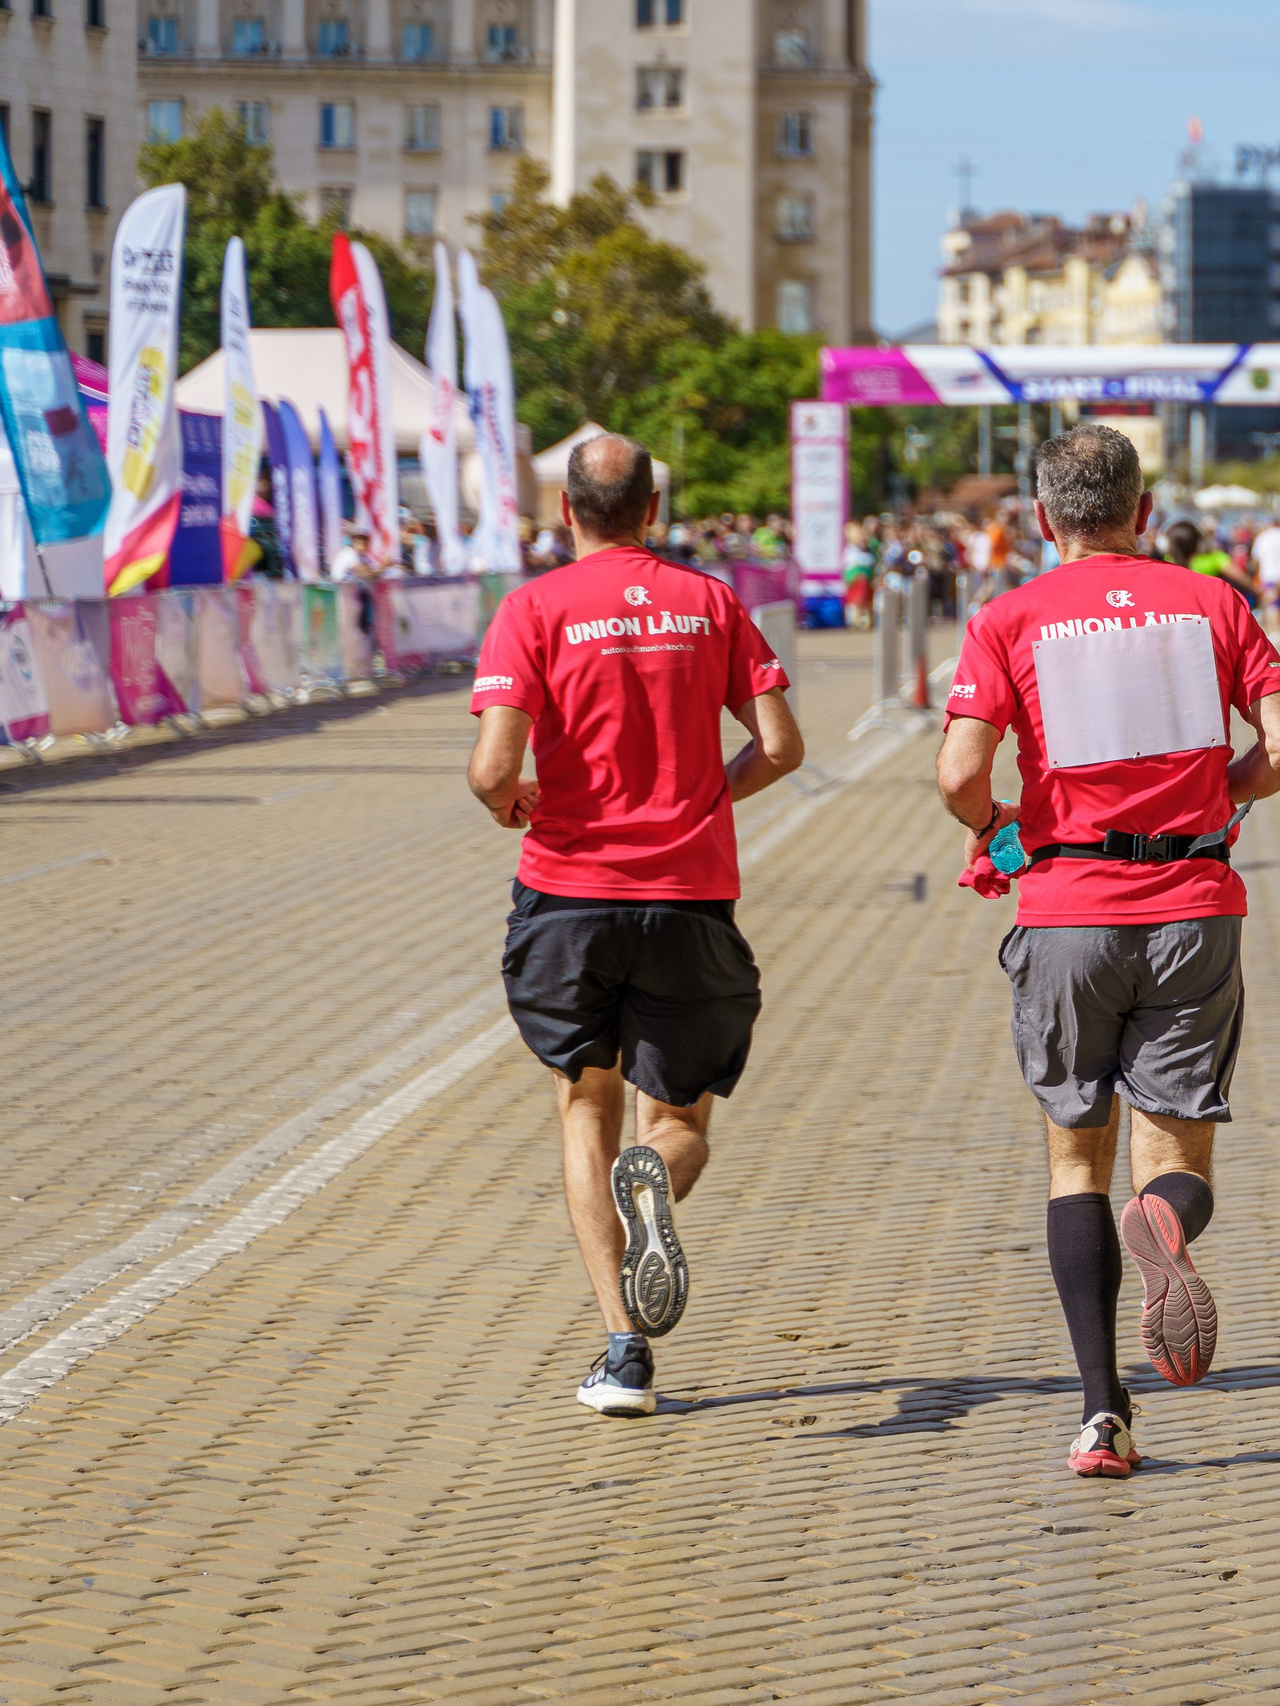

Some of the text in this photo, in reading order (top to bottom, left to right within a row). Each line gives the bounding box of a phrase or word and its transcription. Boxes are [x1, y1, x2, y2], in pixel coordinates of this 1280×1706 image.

[565, 611, 710, 645] UNION LÄUFT
[1040, 617, 1121, 641] UNION
